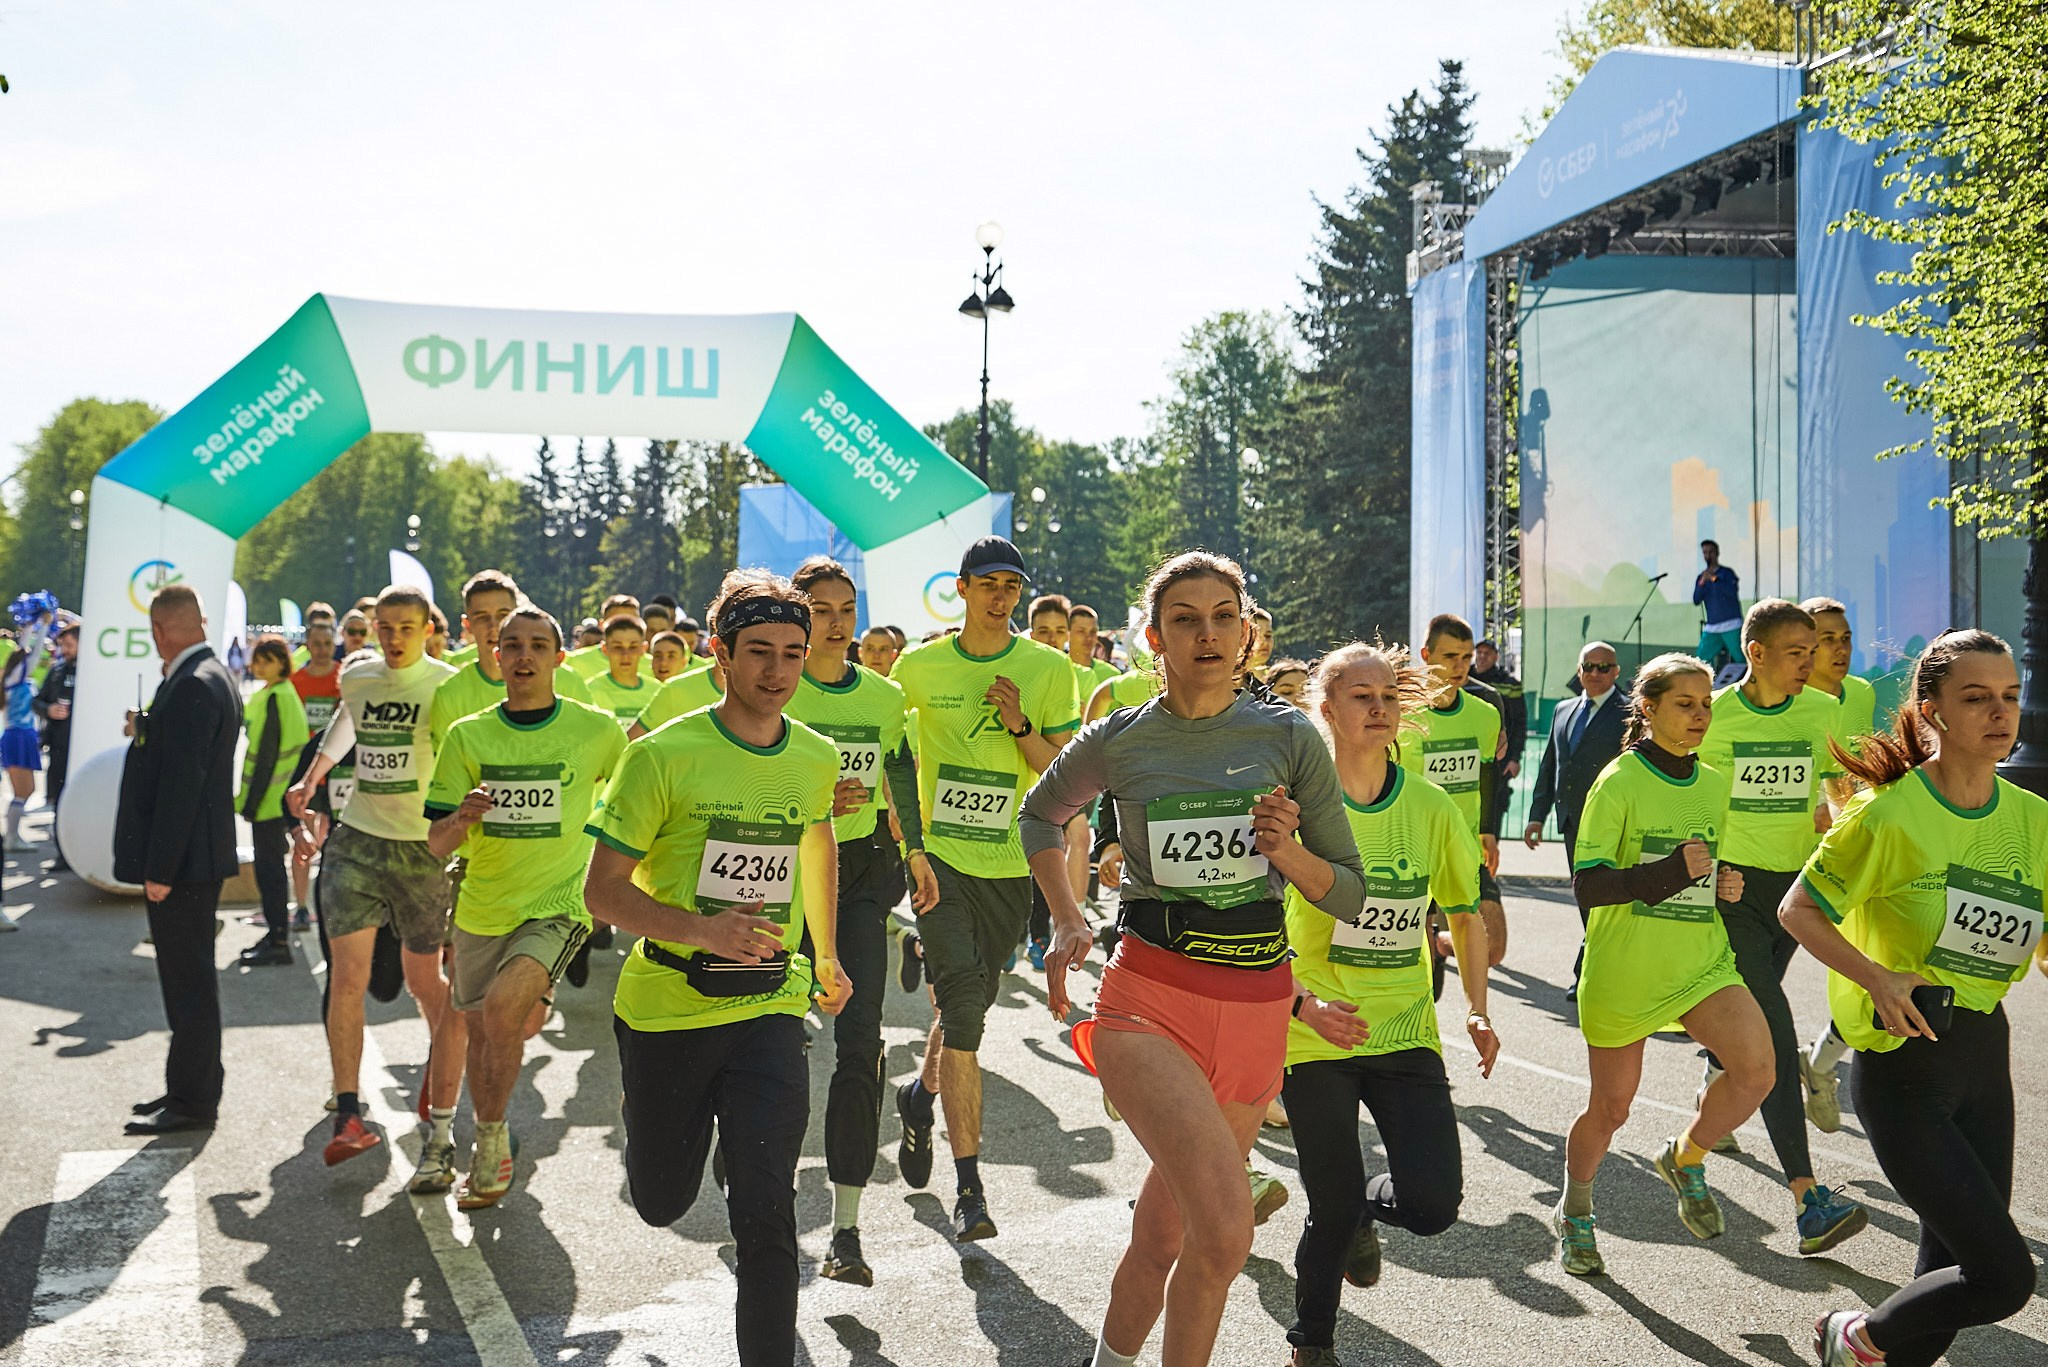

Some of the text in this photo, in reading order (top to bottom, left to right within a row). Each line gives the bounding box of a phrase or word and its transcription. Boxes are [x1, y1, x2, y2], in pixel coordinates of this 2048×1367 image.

[1558, 142, 1597, 183] СБЕР
[402, 334, 718, 398] ФИНИШ
[192, 363, 306, 465] зелёный
[210, 388, 324, 485] марафон
[818, 389, 920, 483] зелёный
[800, 407, 902, 502] марафон
[97, 627, 152, 658] СБ
[360, 752, 409, 769] 42387
[839, 751, 875, 771] 369
[1429, 756, 1476, 773] 42317
[1740, 765, 1805, 784] 42313
[695, 801, 744, 812] зелёный
[941, 788, 1008, 813] 42327
[688, 811, 739, 822] марафон
[710, 852, 788, 882] 42366
[1911, 882, 1947, 891] мара
[1953, 902, 2032, 947] 42321
